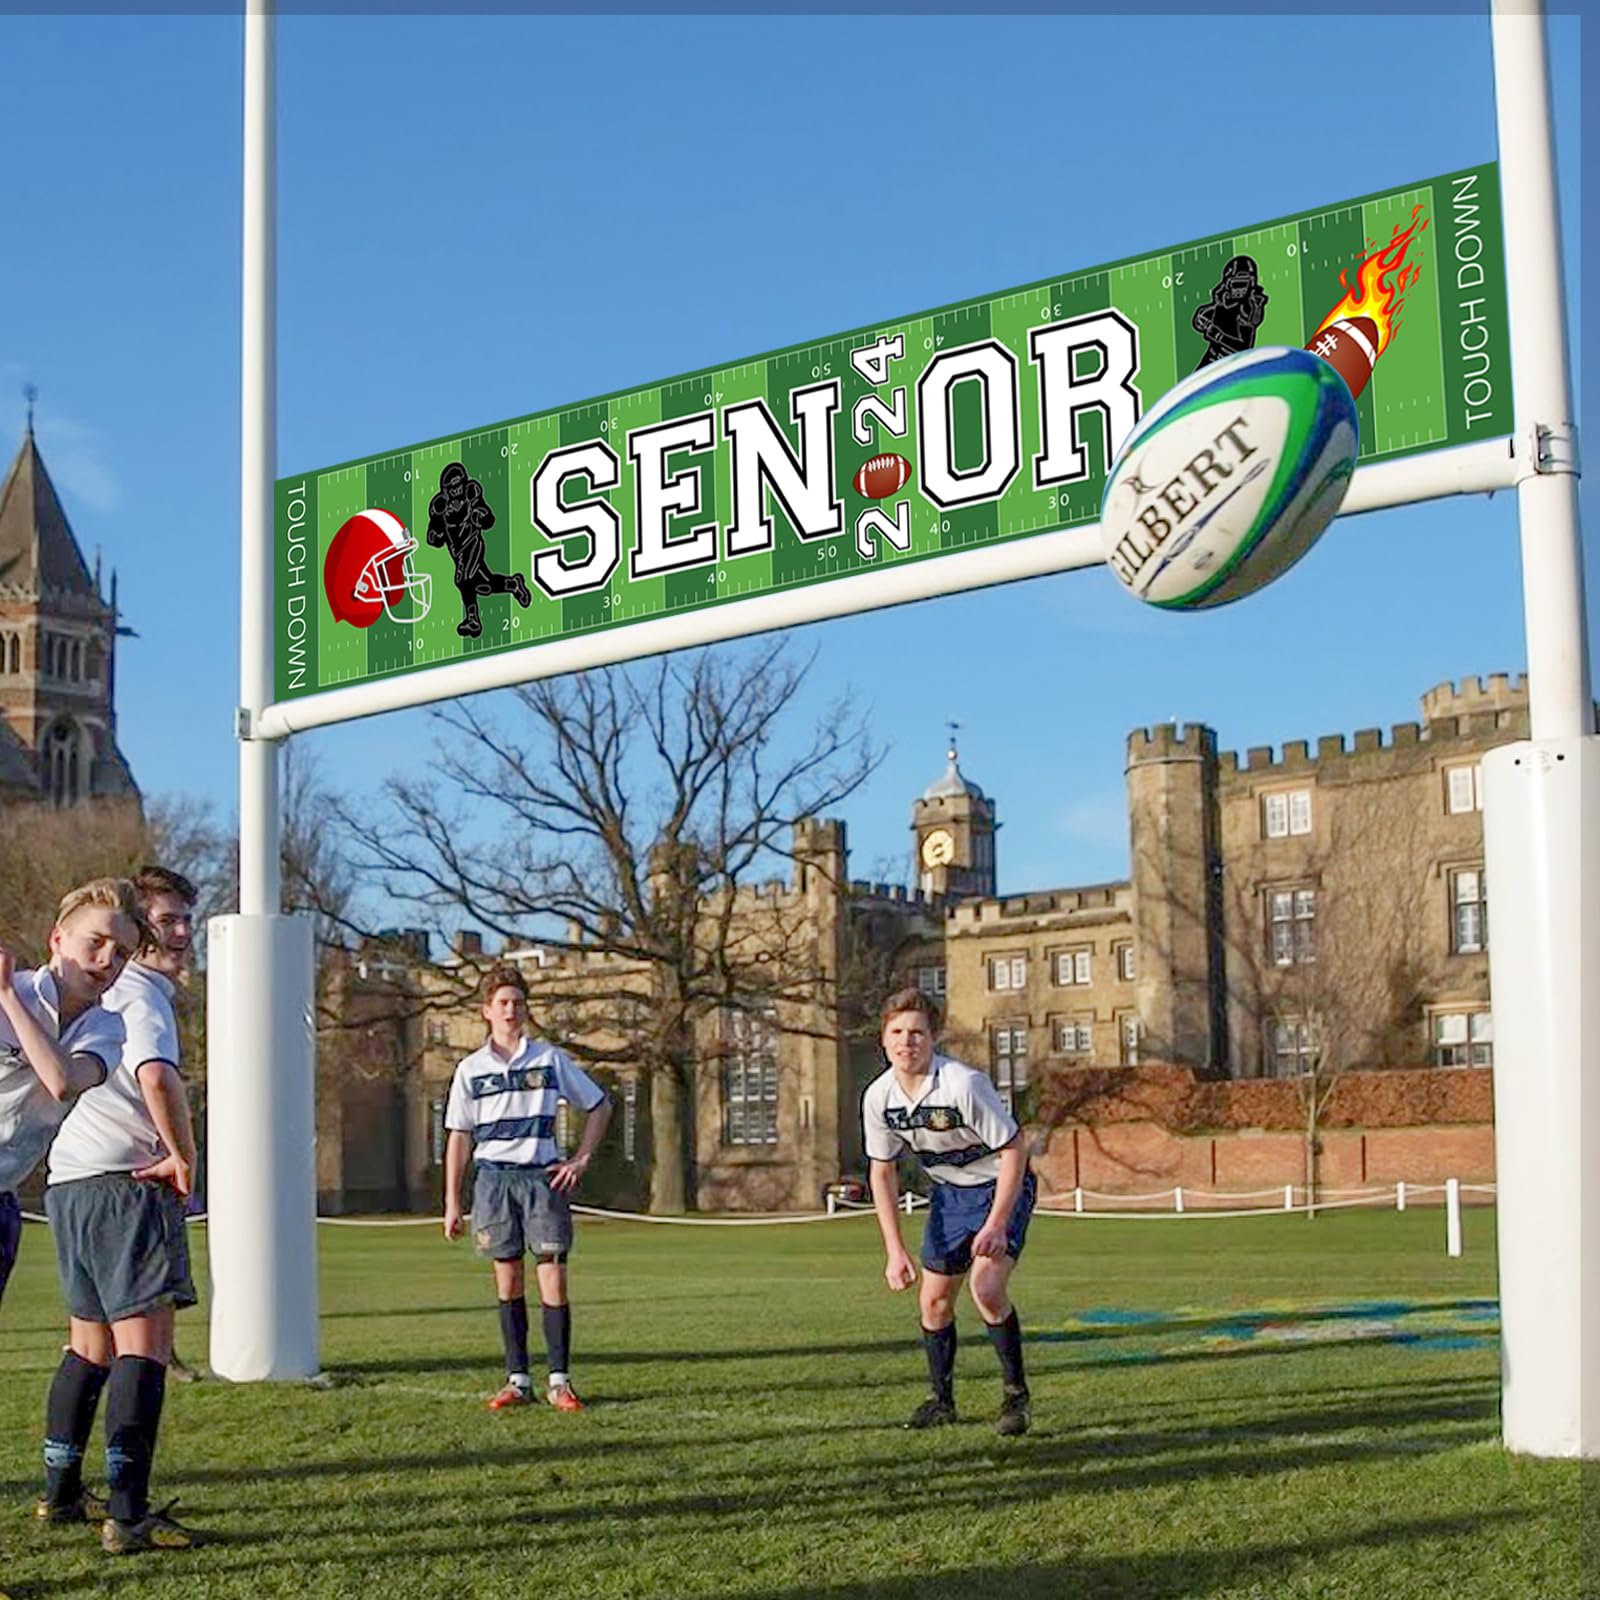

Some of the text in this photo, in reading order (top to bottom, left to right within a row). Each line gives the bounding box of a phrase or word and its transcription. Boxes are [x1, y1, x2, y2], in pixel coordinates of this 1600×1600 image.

[1287, 240, 1309, 257] 10
[1162, 272, 1184, 289] 20
[1452, 174, 1493, 430] TOUCH DOWN
[1041, 303, 1062, 320] 30
[923, 335, 945, 350] 40
[811, 363, 831, 378] 50
[704, 391, 723, 405] 40
[600, 418, 618, 432] 30
[500, 443, 518, 458] 20
[404, 470, 420, 482] 10
[1048, 493, 1070, 508] 30
[929, 519, 951, 535] 40
[817, 545, 837, 561] 50
[707, 570, 727, 584] 40
[287, 480, 307, 690] TOUCH DOWN
[603, 594, 622, 608] 30
[503, 617, 520, 631] 20
[408, 638, 424, 651] 10
